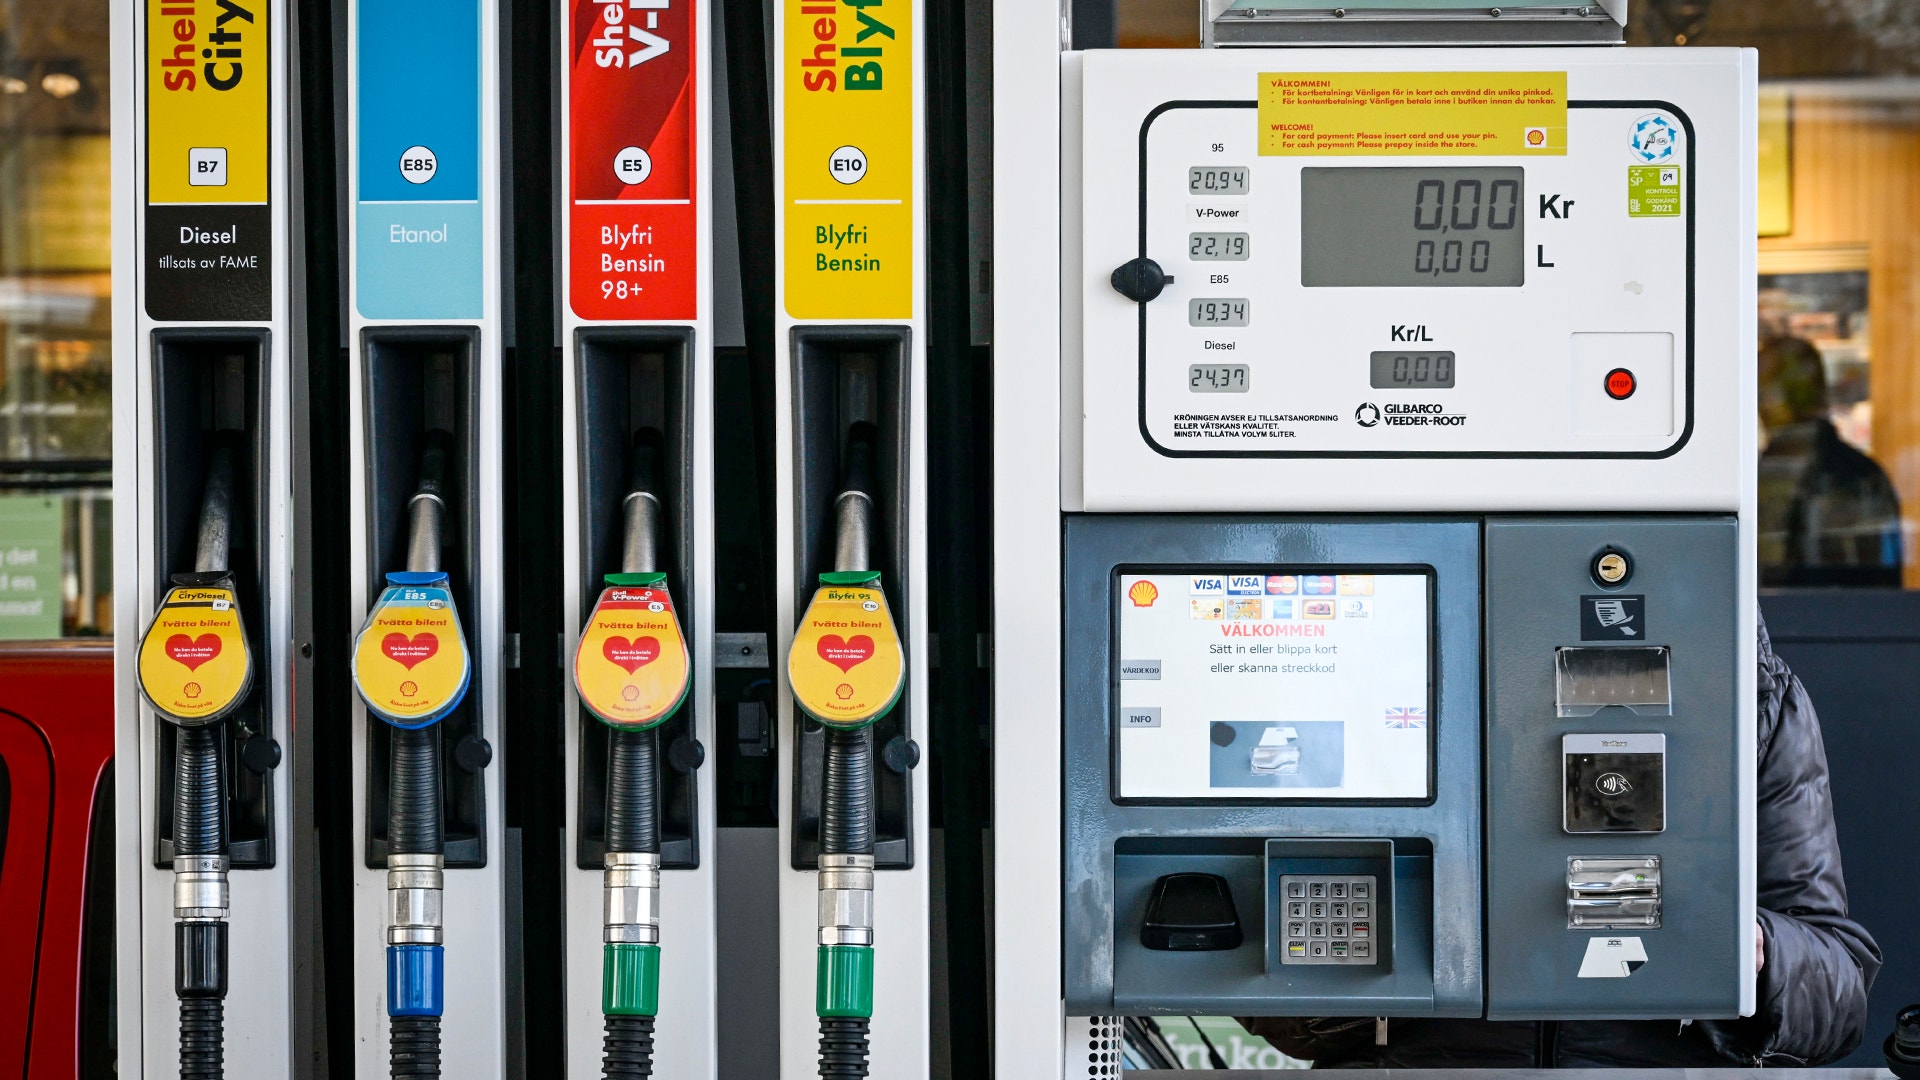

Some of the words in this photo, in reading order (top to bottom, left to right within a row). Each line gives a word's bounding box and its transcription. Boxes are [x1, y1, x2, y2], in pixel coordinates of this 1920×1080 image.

[628, 0, 671, 69] V-
[202, 0, 254, 91] City
[801, 0, 836, 93] Shel
[1271, 80, 1330, 88] VÄLKOMMEN!
[1297, 89, 1353, 97] kortbetalning:
[1355, 88, 1390, 97] Vänligen
[1451, 88, 1482, 96] använd
[1484, 88, 1496, 96] din
[1523, 88, 1553, 97] pinkod.
[1298, 98, 1367, 106] kontantbetalning:
[1370, 97, 1404, 106] Vänligen
[1317, 133, 1354, 141] payment:
[1483, 132, 1497, 140] pin.
[1212, 143, 1224, 152] 95
[1317, 141, 1354, 149] payment:
[198, 161, 218, 172] B7
[404, 159, 433, 171] E85
[623, 160, 642, 171] E5
[834, 159, 862, 171] E10
[1191, 172, 1244, 191] 20,94
[1630, 177, 1643, 186] SP
[1414, 179, 1519, 234] 0,00
[1540, 194, 1575, 219] Kr
[1196, 208, 1239, 218] V-Power
[180, 225, 236, 244] Diesel
[390, 223, 447, 243] Etanol
[601, 224, 652, 250] Blyfri
[816, 224, 867, 250] Blyfri
[1191, 238, 1244, 257] 22,19
[1415, 240, 1490, 277] 0,00
[1537, 244, 1554, 267] L
[159, 255, 196, 269] tillsats
[200, 260, 215, 268] av
[220, 256, 257, 268] FAME
[602, 253, 665, 272] Bensin
[816, 253, 880, 271] Bensin
[1210, 274, 1229, 284] E85
[601, 280, 643, 299] 98+
[1198, 303, 1244, 322] 19,34
[1391, 325, 1433, 342] Kr/L
[1204, 340, 1235, 350] Diesel
[1393, 356, 1450, 385] 0,00
[1191, 369, 1244, 388] 24,37
[1611, 380, 1629, 388] STOP
[1384, 404, 1443, 414] GILBARCO
[1174, 413, 1219, 421] KRÖNINGEN
[1384, 416, 1466, 426] VEEDER-ROOT
[1200, 421, 1240, 430] VÄTSKANS
[1193, 579, 1222, 590] VISA
[1232, 577, 1260, 587] VISA
[828, 592, 855, 600] Blyfri
[1221, 622, 1325, 637] VÄLKOMMEN
[1209, 644, 1232, 654] Sätt
[1236, 644, 1246, 654] in
[1250, 644, 1273, 654] eller
[1277, 644, 1311, 656] blippa
[1315, 644, 1337, 654] kort
[1122, 665, 1160, 674] VÄRDEKOD
[1210, 662, 1234, 673] eller
[1238, 663, 1278, 673] skanna
[1282, 663, 1335, 673] streckkod
[1130, 715, 1152, 723] INFO
